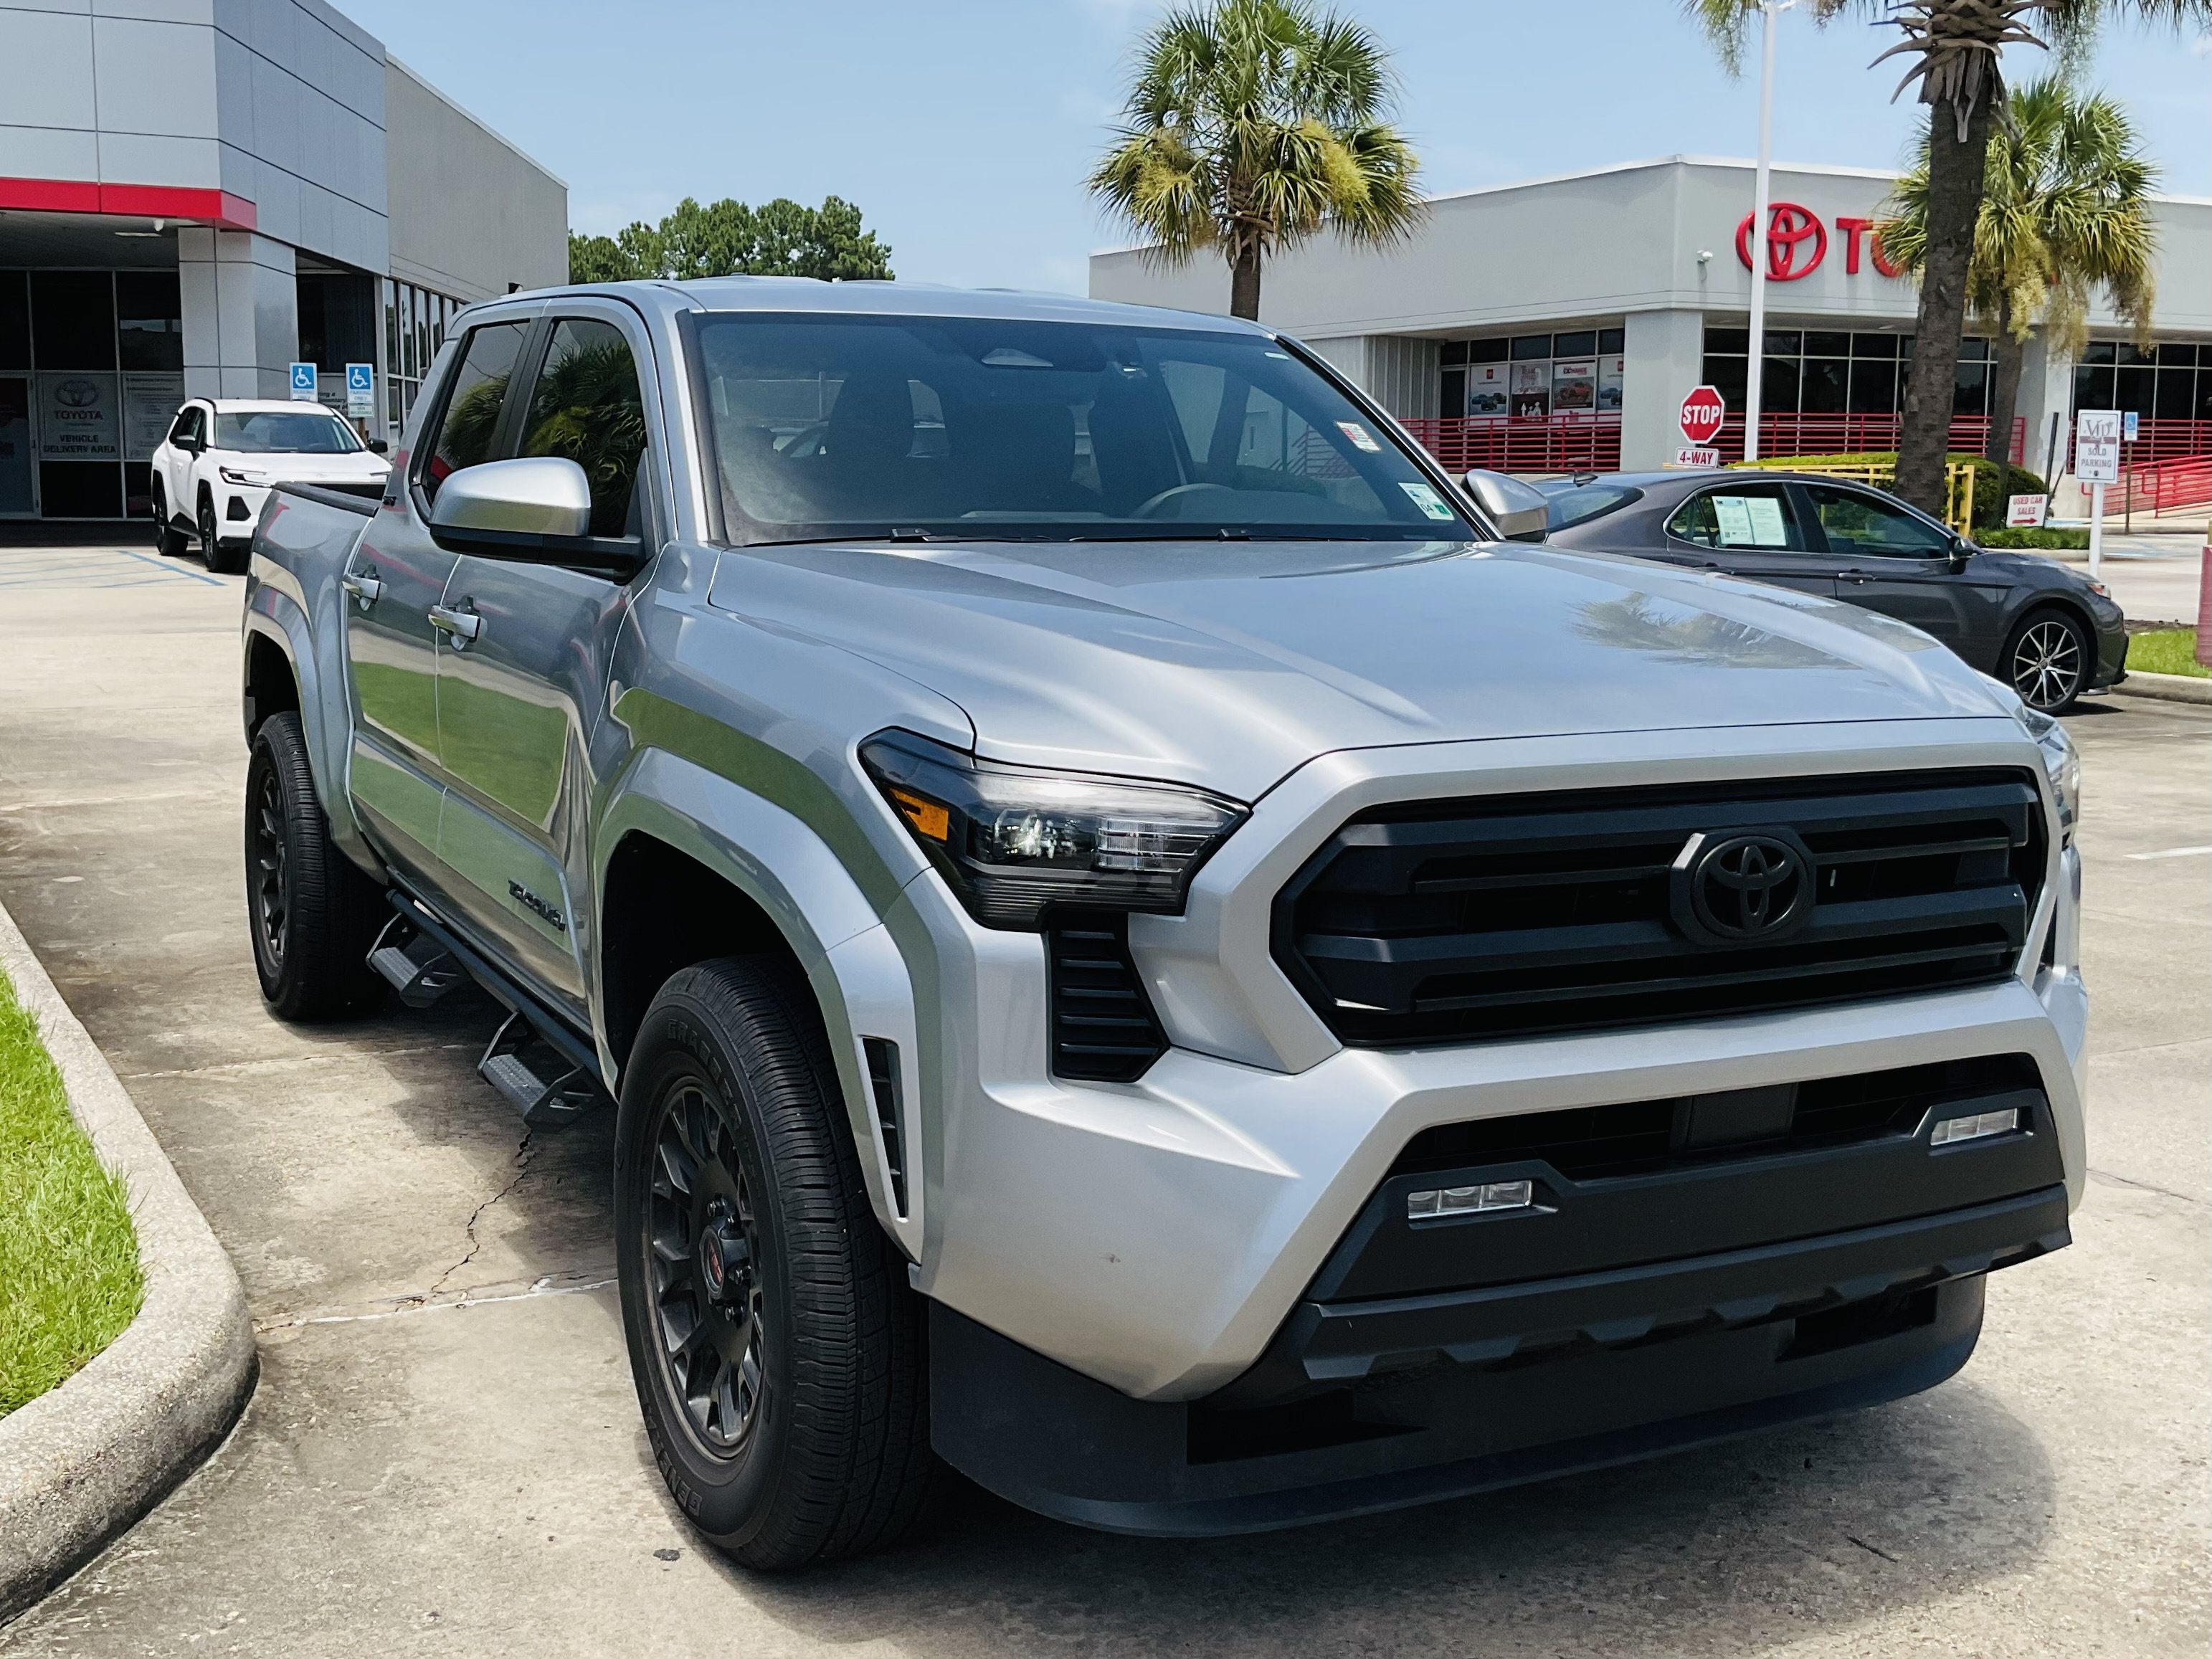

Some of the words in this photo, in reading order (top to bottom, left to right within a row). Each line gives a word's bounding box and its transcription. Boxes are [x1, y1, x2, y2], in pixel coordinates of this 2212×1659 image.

[54, 410, 103, 420] TOYOTA
[1683, 405, 1720, 424] STOP
[60, 434, 99, 443] VEHICLE
[43, 445, 87, 453] DELIVERY
[90, 445, 116, 453] AREA
[2088, 447, 2107, 456] SOLD
[1680, 451, 1713, 465] 4-WAY
[2081, 459, 2112, 468] PARKING
